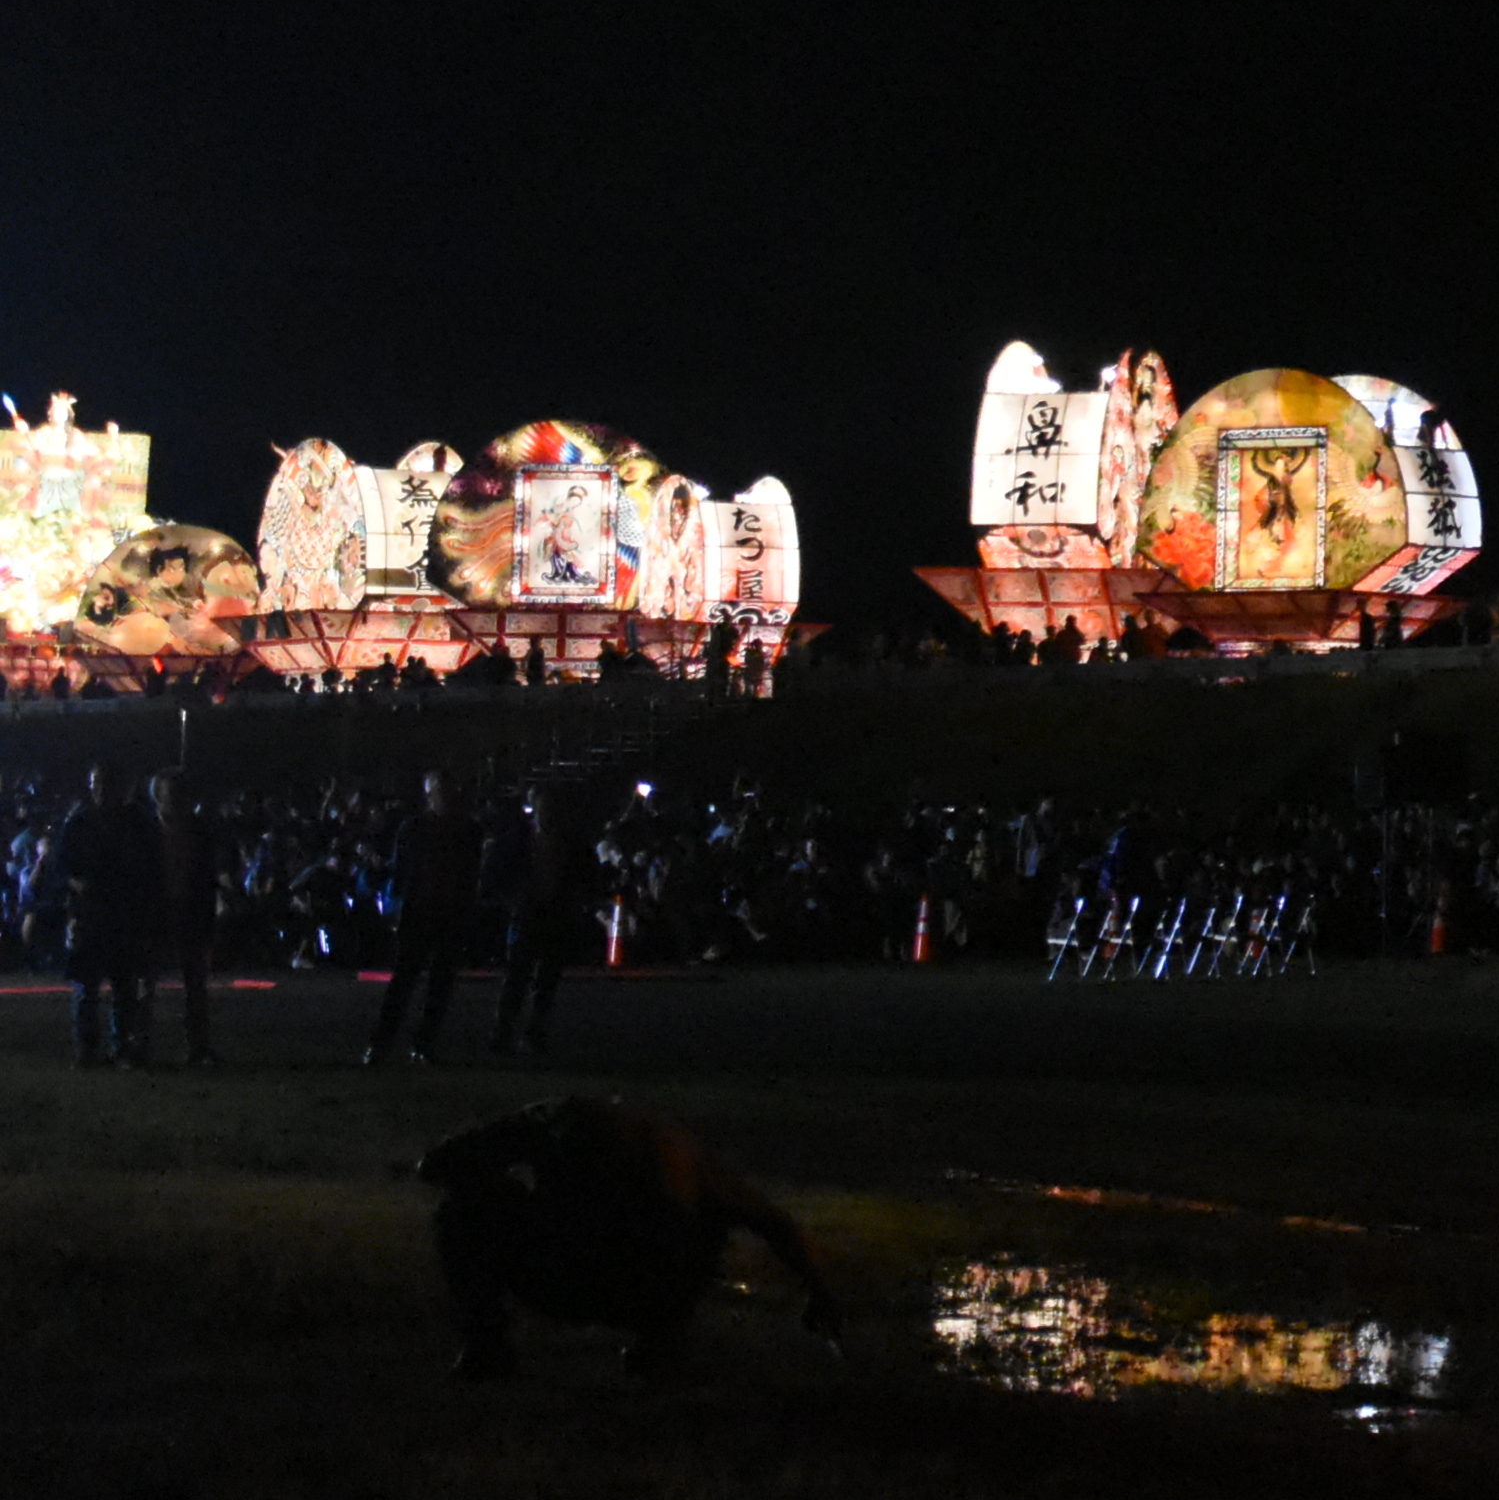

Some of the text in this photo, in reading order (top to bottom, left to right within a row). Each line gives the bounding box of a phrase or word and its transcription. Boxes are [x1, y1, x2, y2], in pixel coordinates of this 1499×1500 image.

[1005, 400, 1068, 518] 鼻和
[731, 506, 765, 602] たつ屋
